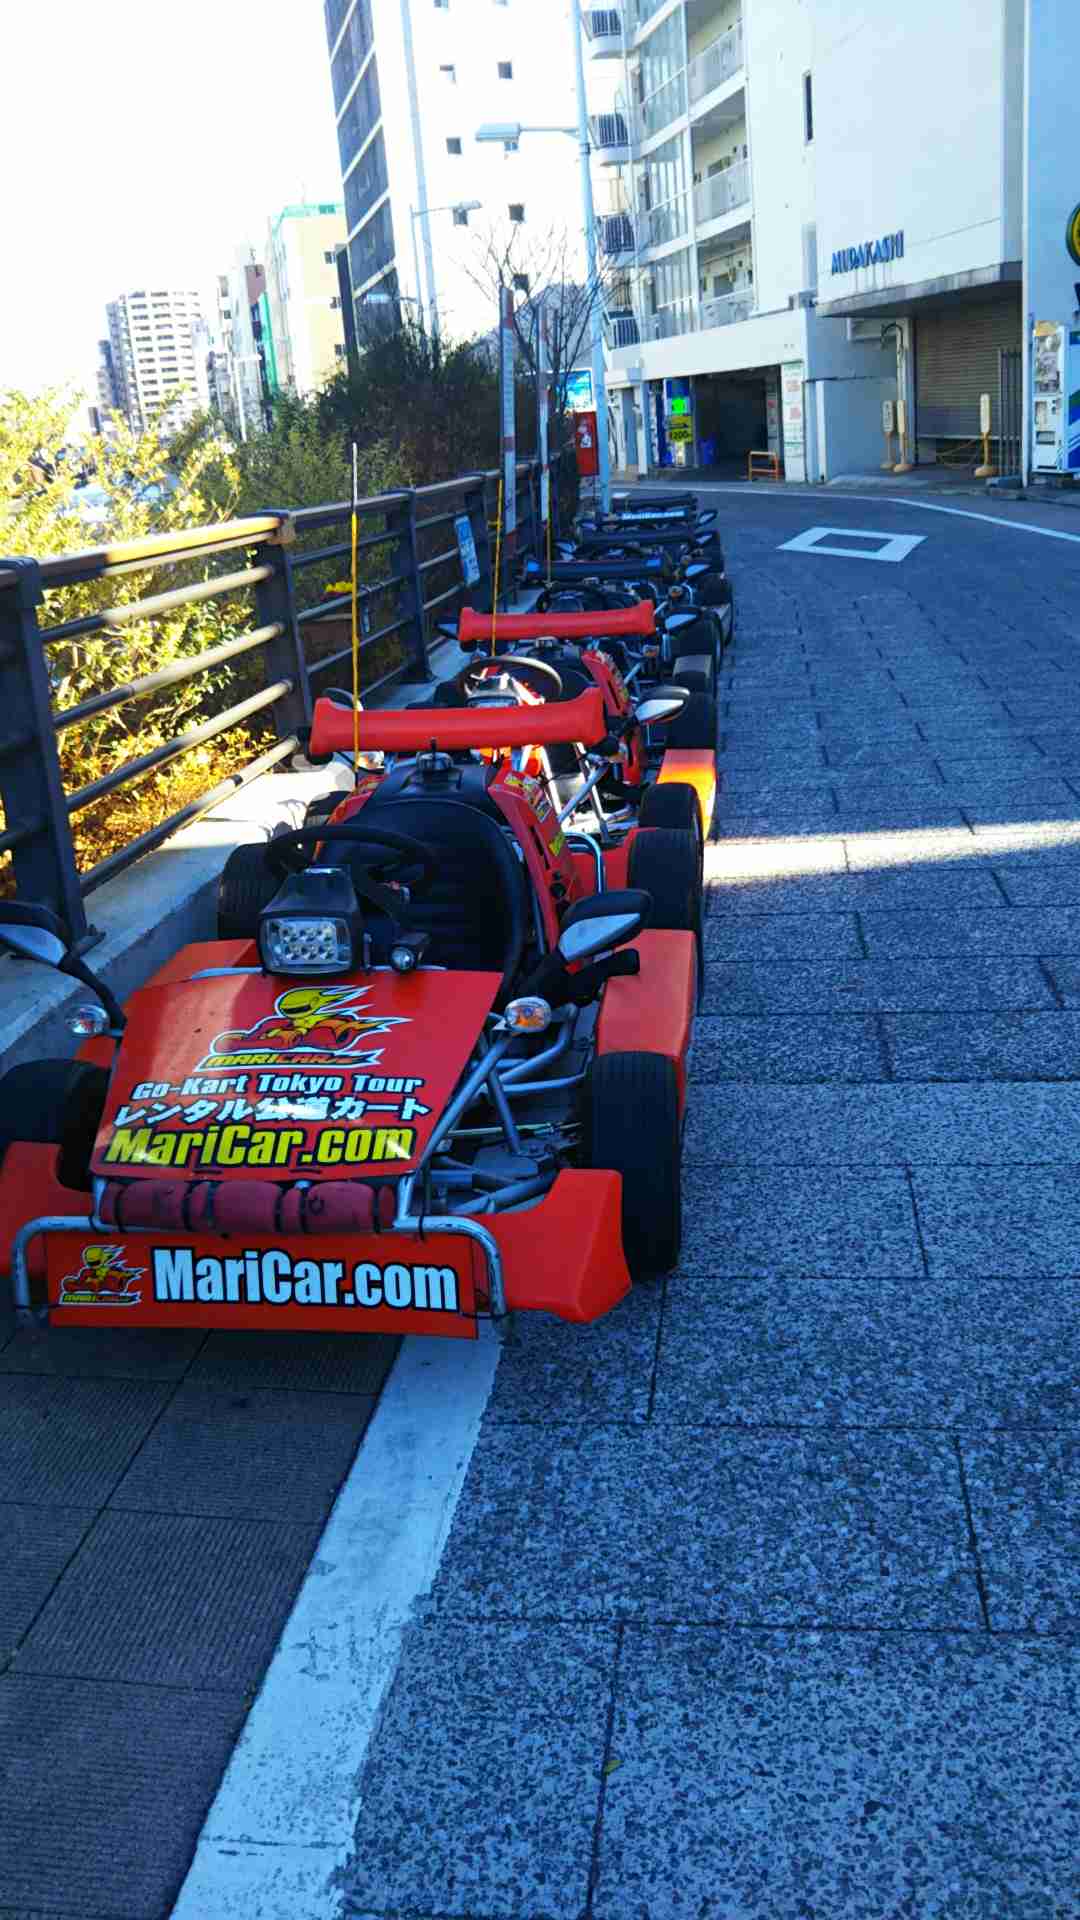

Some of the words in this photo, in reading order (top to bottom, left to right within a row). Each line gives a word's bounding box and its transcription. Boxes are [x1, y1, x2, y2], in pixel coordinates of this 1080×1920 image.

[131, 1075, 249, 1100] Go-Kart
[258, 1074, 344, 1096] Tokyo
[352, 1074, 423, 1094] Tour
[104, 1125, 416, 1166] MariCar.com
[152, 1248, 460, 1311] MariCar.com
